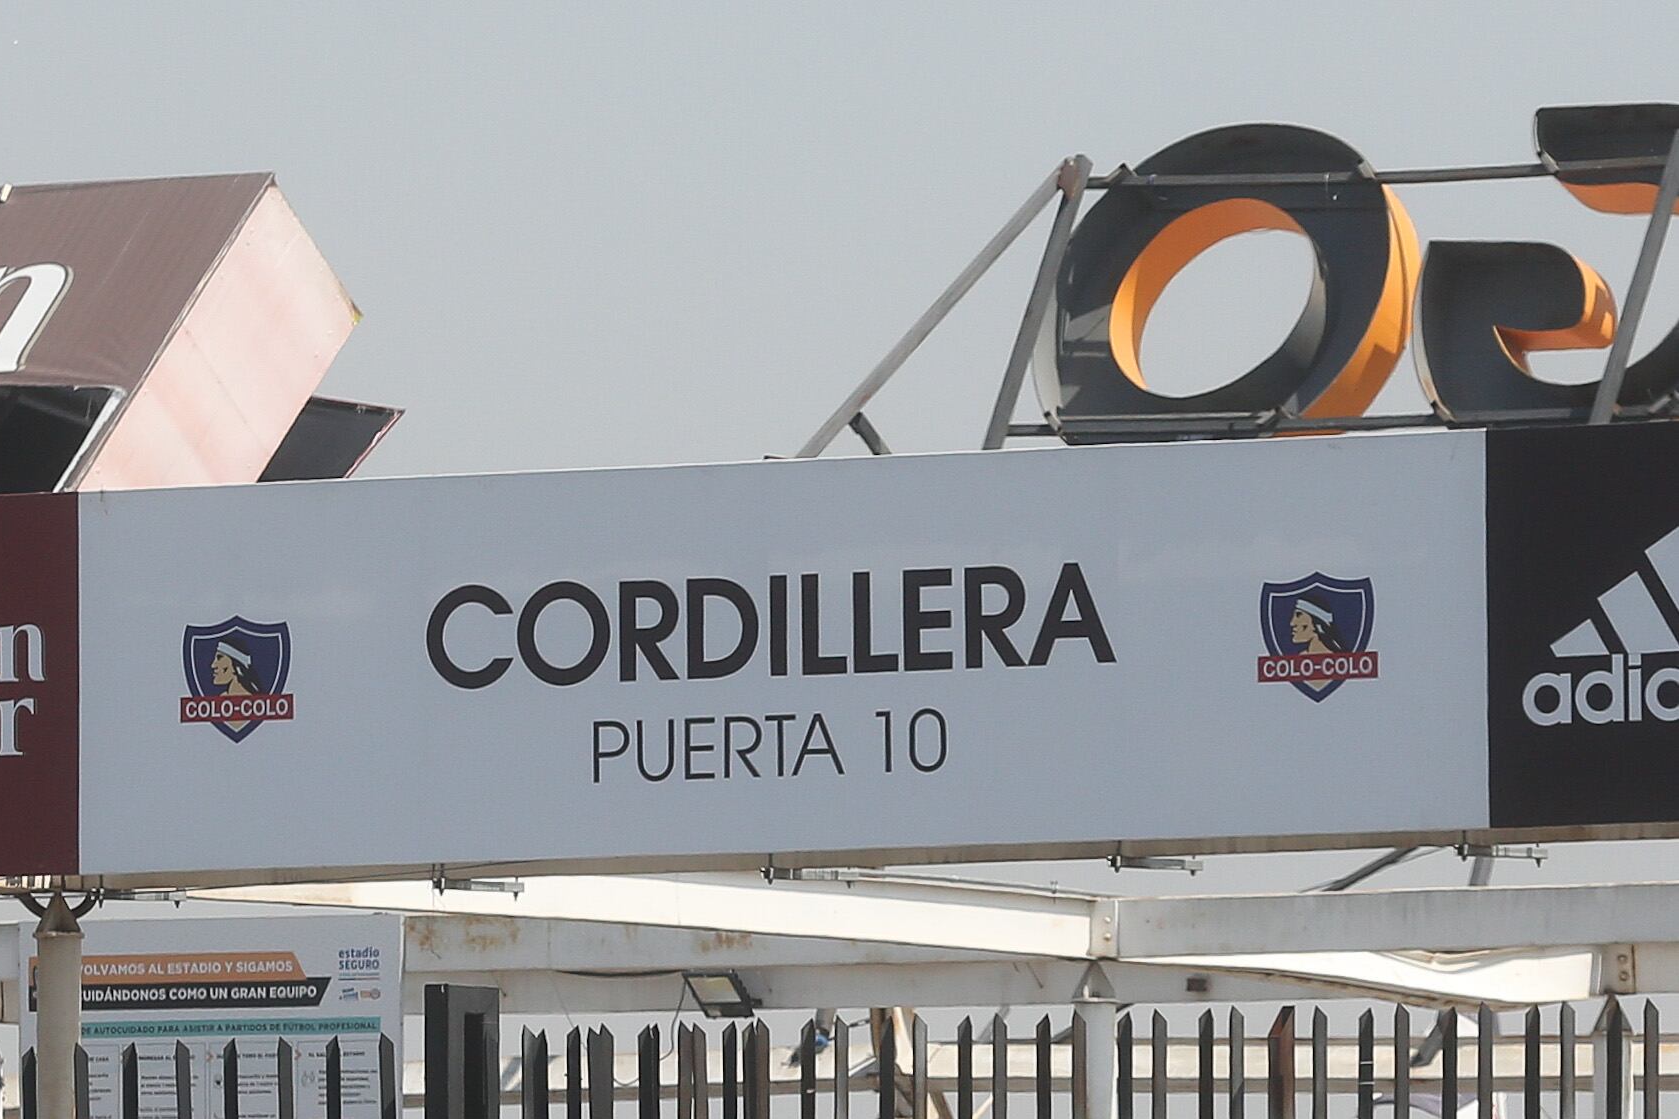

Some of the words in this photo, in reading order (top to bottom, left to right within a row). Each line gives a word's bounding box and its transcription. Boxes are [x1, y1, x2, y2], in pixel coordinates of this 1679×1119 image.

[425, 561, 1118, 690] CORDILLERA
[1262, 655, 1374, 679] COLO-COLO
[185, 697, 290, 719] COLO-COLO
[592, 712, 846, 784] PUERTA
[875, 706, 949, 774] 10
[338, 946, 380, 959] estadio
[82, 962, 145, 976] OLVAMOS
[148, 963, 165, 975] AL
[167, 961, 222, 975] ESTADIO
[224, 961, 233, 973] Y
[236, 960, 293, 973] SIGAMOS
[338, 959, 380, 970] SEGURO
[83, 986, 166, 1002] UIDÁNDONOS
[169, 988, 207, 1001] COMO
[210, 986, 228, 999] UN
[231, 986, 267, 1000] GRAN
[269, 985, 317, 999] EQUIPO
